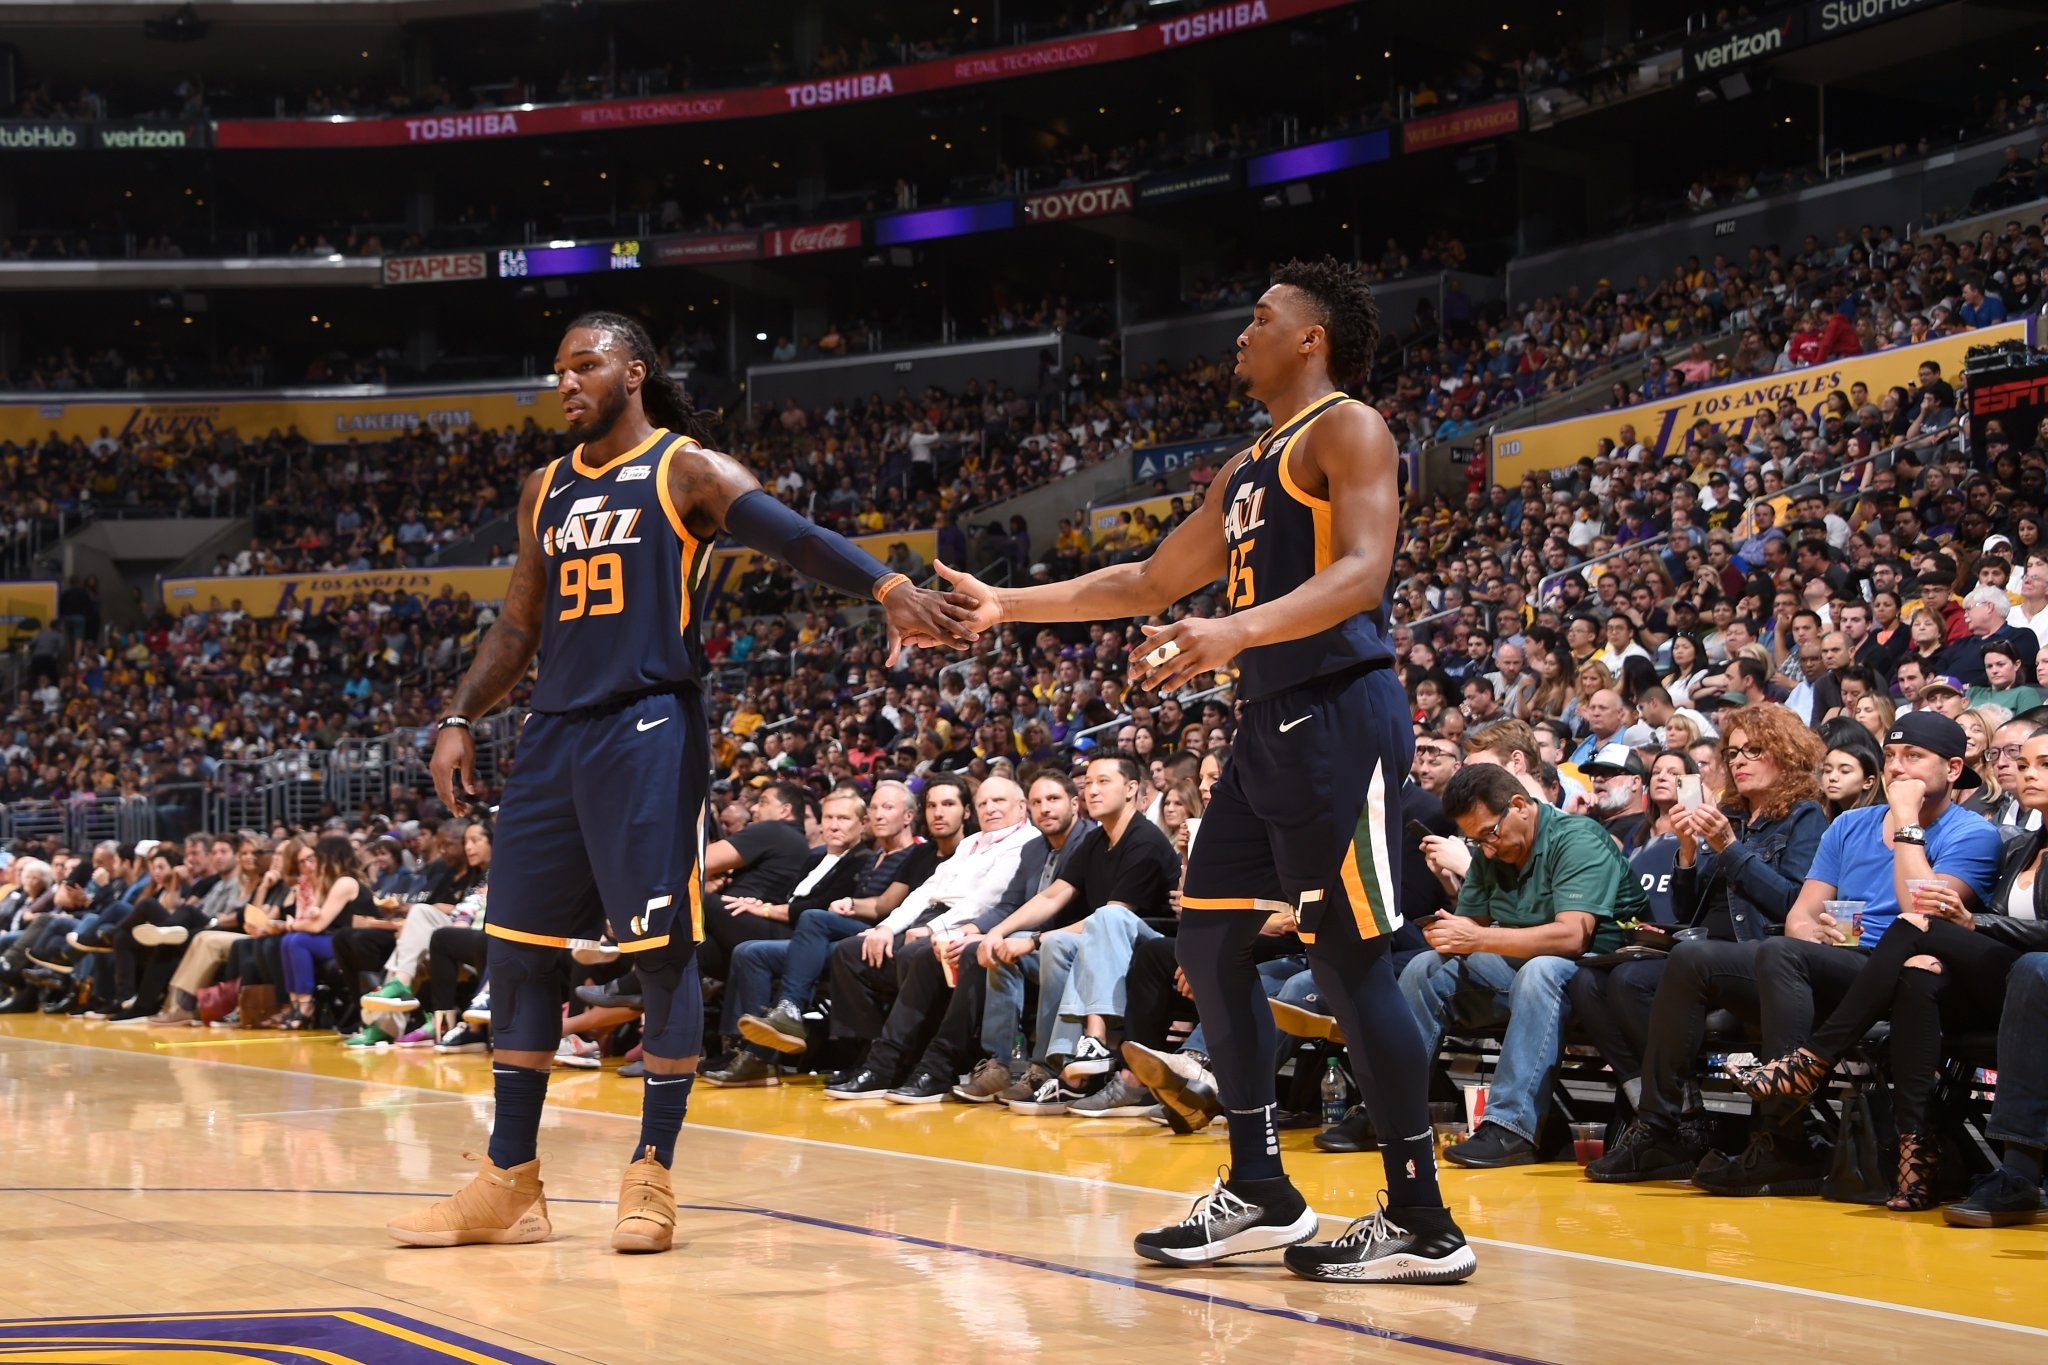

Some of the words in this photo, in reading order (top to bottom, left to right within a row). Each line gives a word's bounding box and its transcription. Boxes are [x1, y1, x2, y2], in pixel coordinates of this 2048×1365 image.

[1159, 0, 1269, 46] TOSHIBA
[955, 60, 999, 78] RETAIL
[1003, 43, 1098, 69] TECHNOLOGY
[1694, 27, 1782, 72] verizon
[786, 72, 894, 108] TOSHIBA
[581, 107, 625, 123] RETAIL
[629, 99, 726, 119] TECHNOLOGY
[102, 126, 186, 148] verizon
[405, 113, 518, 141] TOSHIBA
[1407, 117, 1460, 144] WELLS
[1464, 108, 1518, 134] FARGO
[1140, 181, 1188, 198] AMERICAN
[1190, 173, 1231, 189] EXPRESS
[1029, 187, 1131, 219] TOYOTA
[386, 255, 483, 282] STAPLES
[611, 255, 640, 269] NHL
[1692, 397, 1730, 417] LOS
[1736, 371, 1841, 409] ANGELES
[336, 410, 472, 432] LAKERSCOM
[1499, 441, 1520, 457] 110
[544, 495, 642, 556] JAZZ
[311, 579, 341, 590] LOS
[346, 576, 431, 589] ANGELES
[559, 552, 624, 621] 99
[1396, 1260, 1409, 1268] 45
